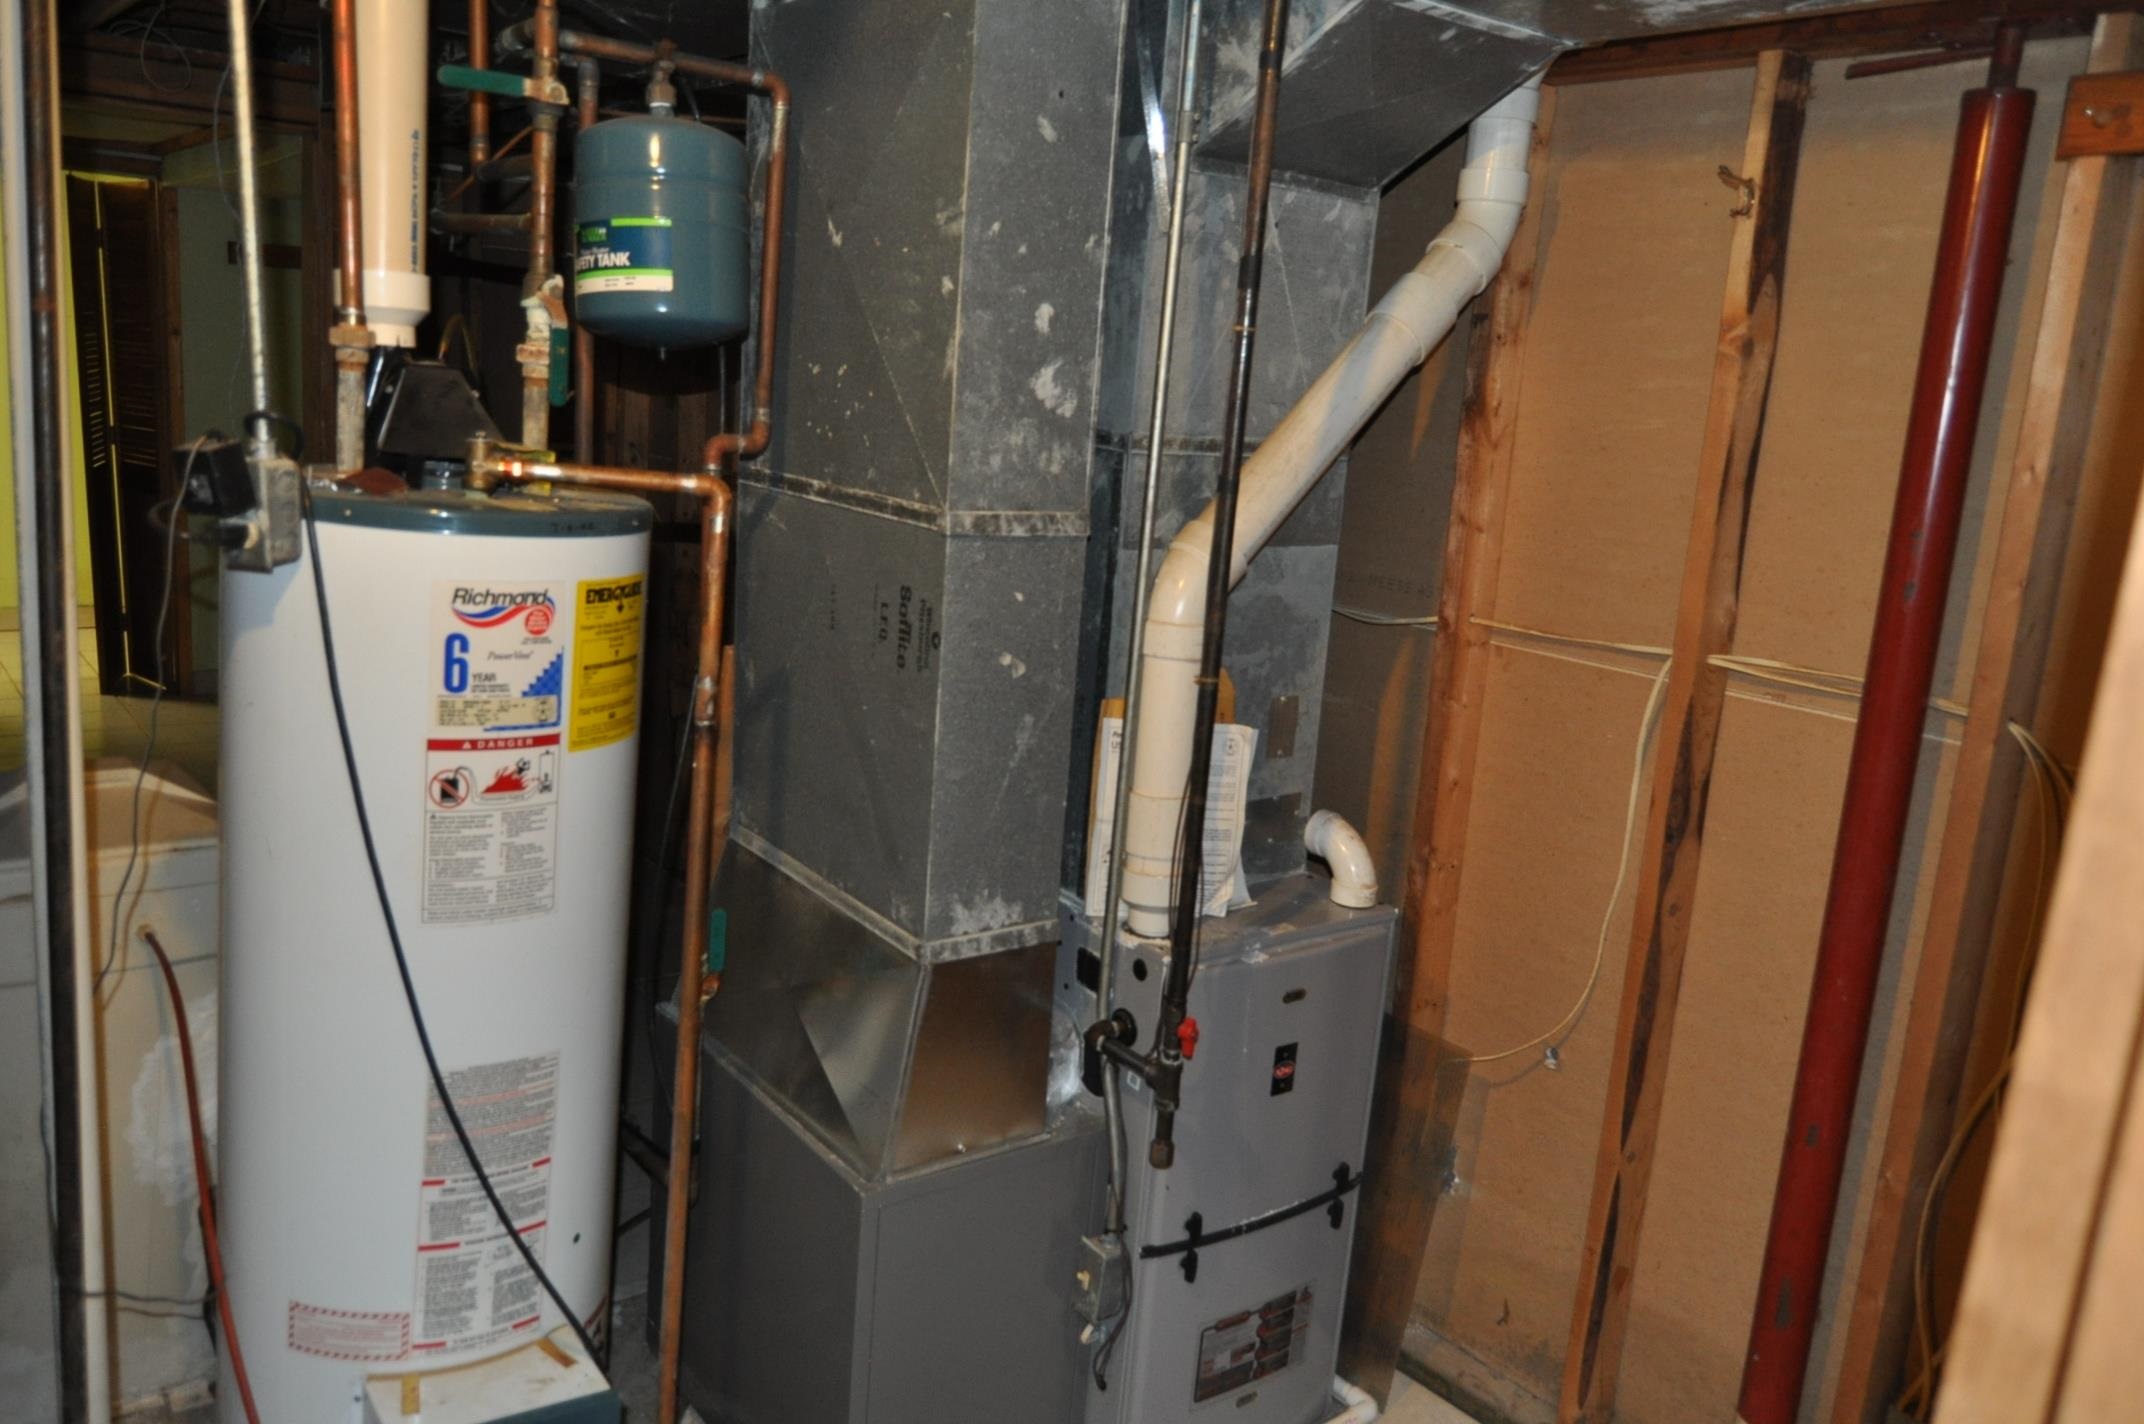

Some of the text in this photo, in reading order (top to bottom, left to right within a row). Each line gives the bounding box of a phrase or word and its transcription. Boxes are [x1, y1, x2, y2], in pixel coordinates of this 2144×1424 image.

[597, 251, 631, 267] TANK
[453, 588, 549, 605] Richmond
[444, 633, 469, 693] 6
[472, 673, 497, 682] YEAR
[477, 738, 534, 748] DANGER
